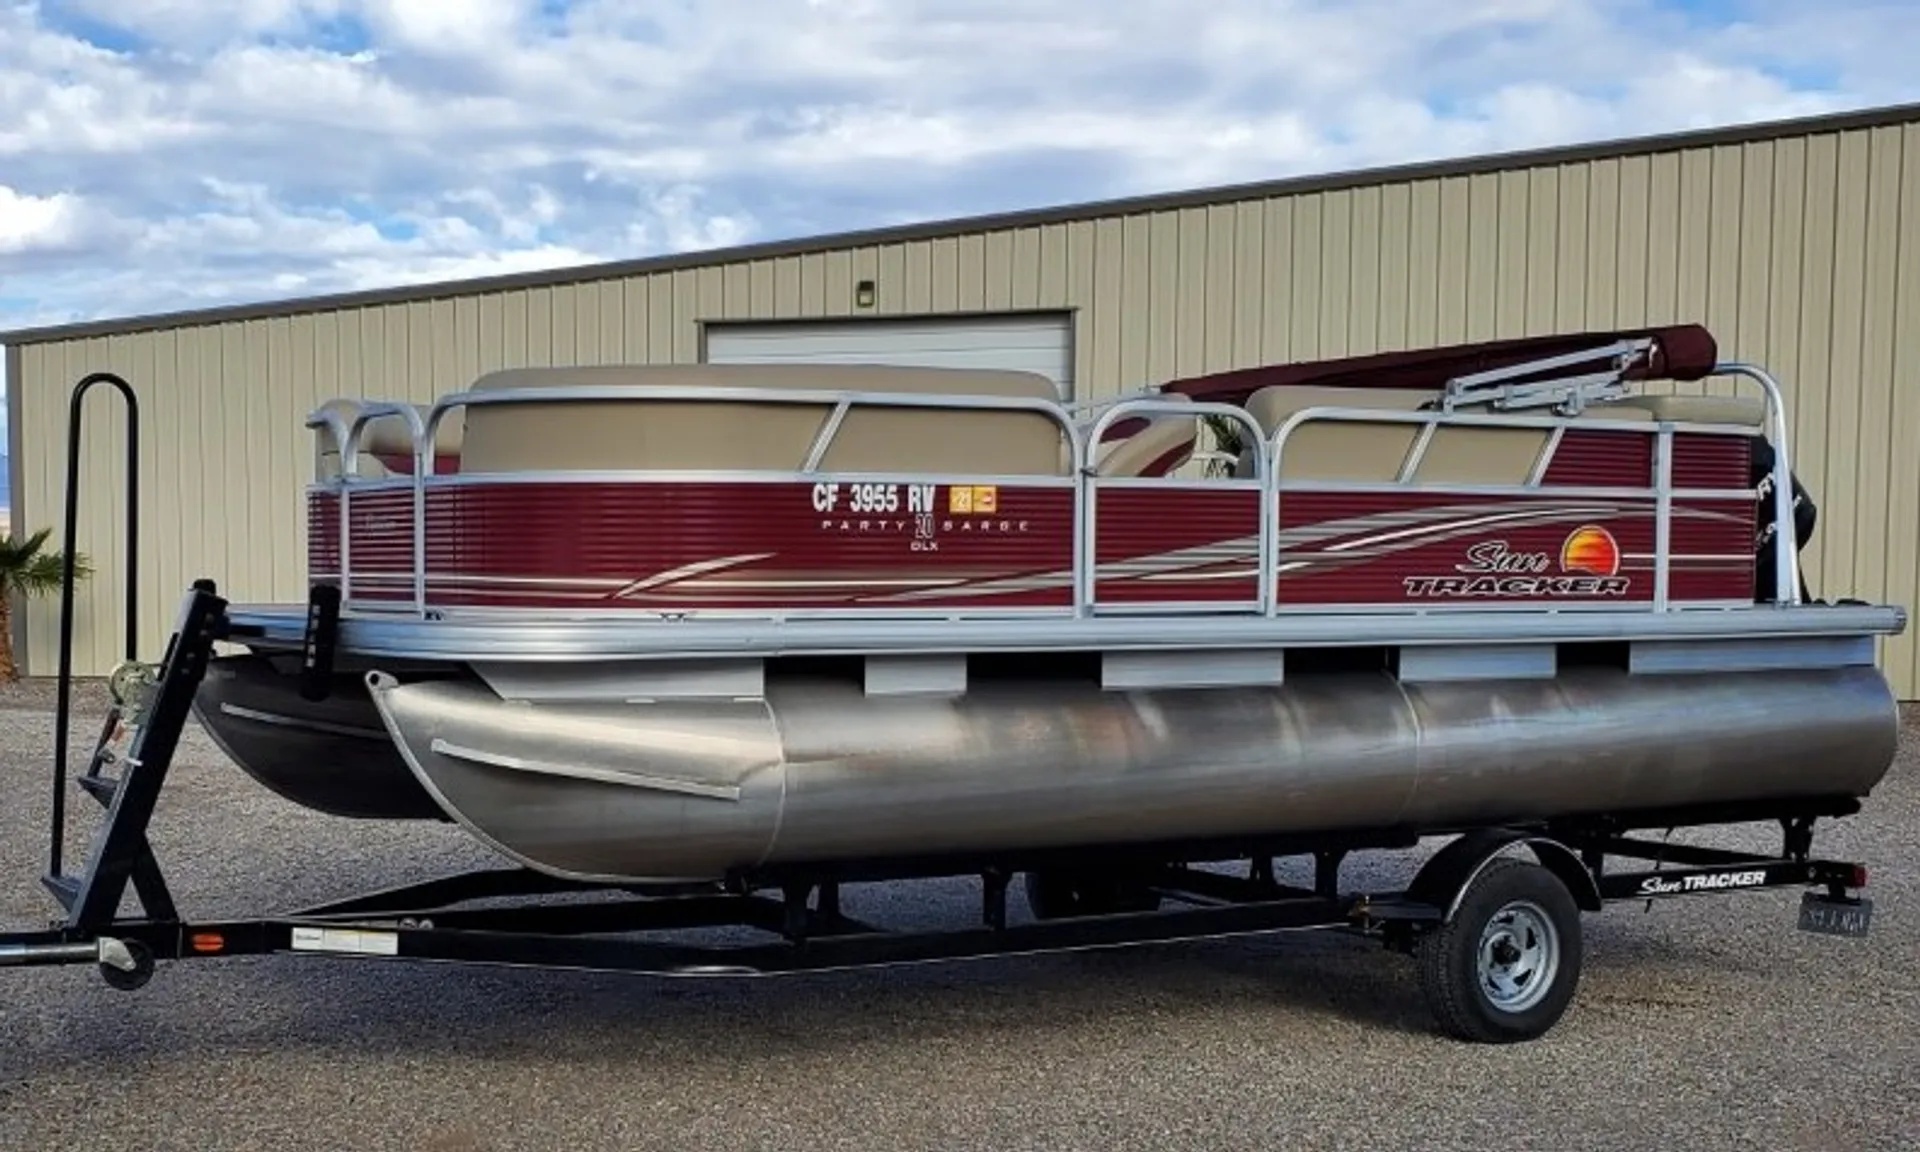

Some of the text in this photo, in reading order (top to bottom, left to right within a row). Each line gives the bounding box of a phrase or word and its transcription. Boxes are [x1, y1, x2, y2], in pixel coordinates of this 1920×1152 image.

[812, 484, 839, 512] CF
[850, 484, 899, 512] 3955
[908, 484, 936, 512] RV
[822, 513, 1028, 539] PARTY 20 BARGE
[1455, 540, 1549, 572] Sun
[1403, 576, 1631, 596] TRACKER
[1641, 871, 1766, 894] Sun TRACKER
